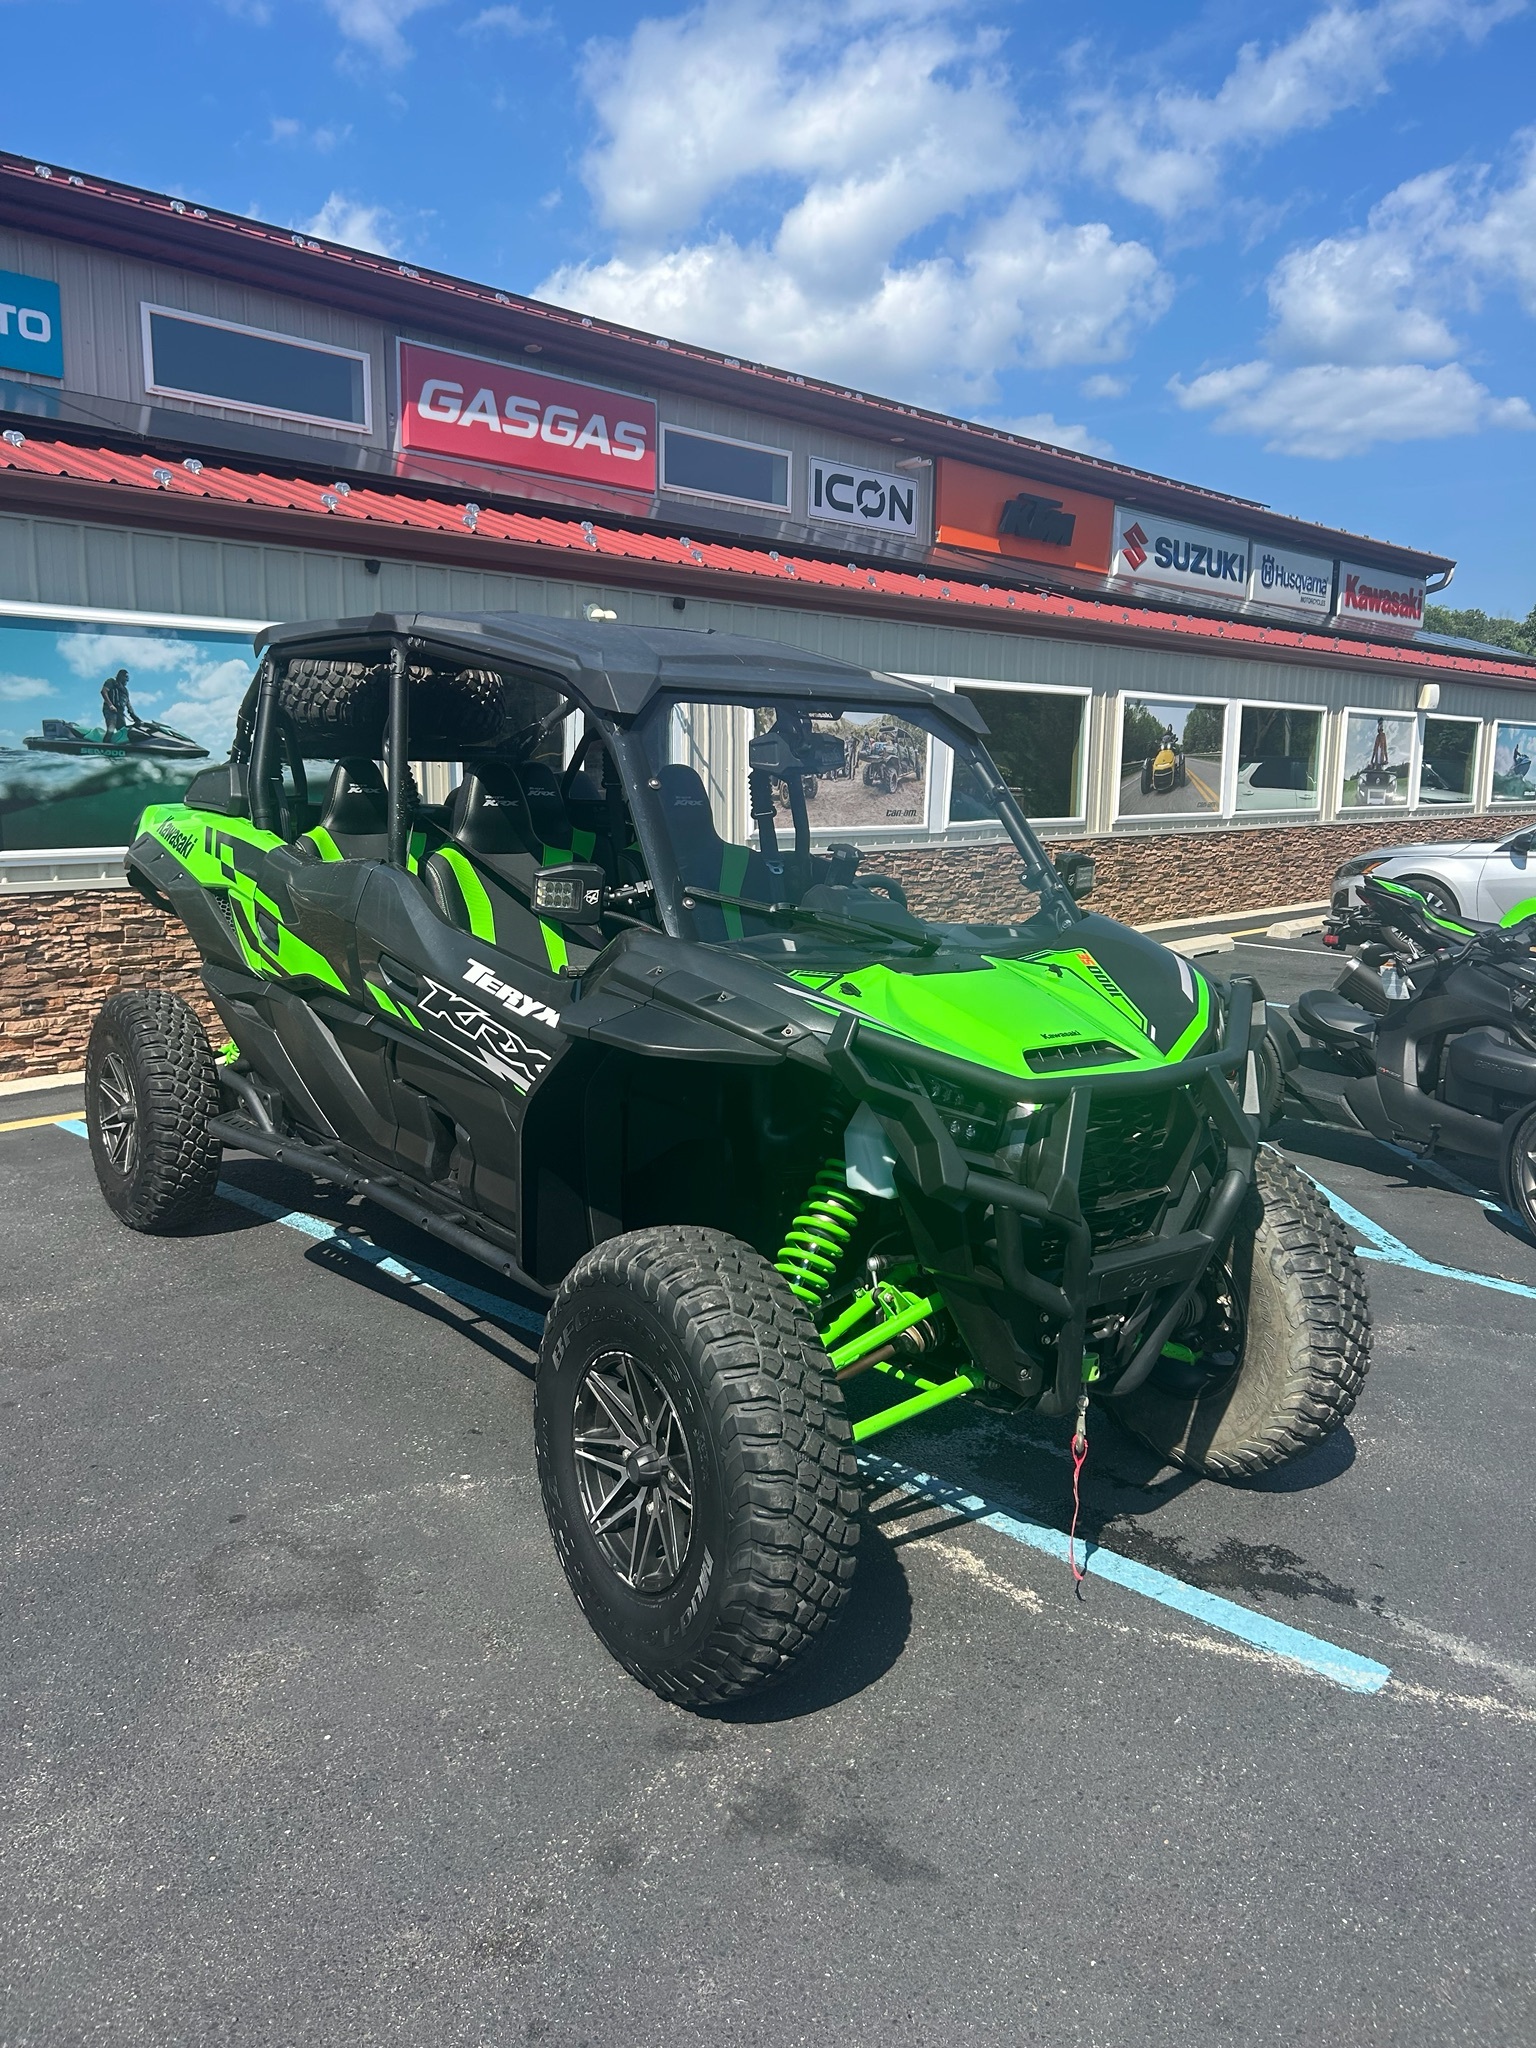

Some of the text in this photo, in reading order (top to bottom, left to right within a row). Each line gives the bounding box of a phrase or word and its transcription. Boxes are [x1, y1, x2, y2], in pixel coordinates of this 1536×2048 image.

[417, 378, 648, 462] GASGAS
[814, 467, 914, 526] ICON
[998, 492, 1077, 547] KTM
[1154, 536, 1245, 584] SUZUKI
[1275, 564, 1329, 595] Husqvarna
[1344, 573, 1424, 621] Kawasaki
[156, 814, 199, 860] Kawasaki
[1040, 1029, 1082, 1040] Kawasaki
